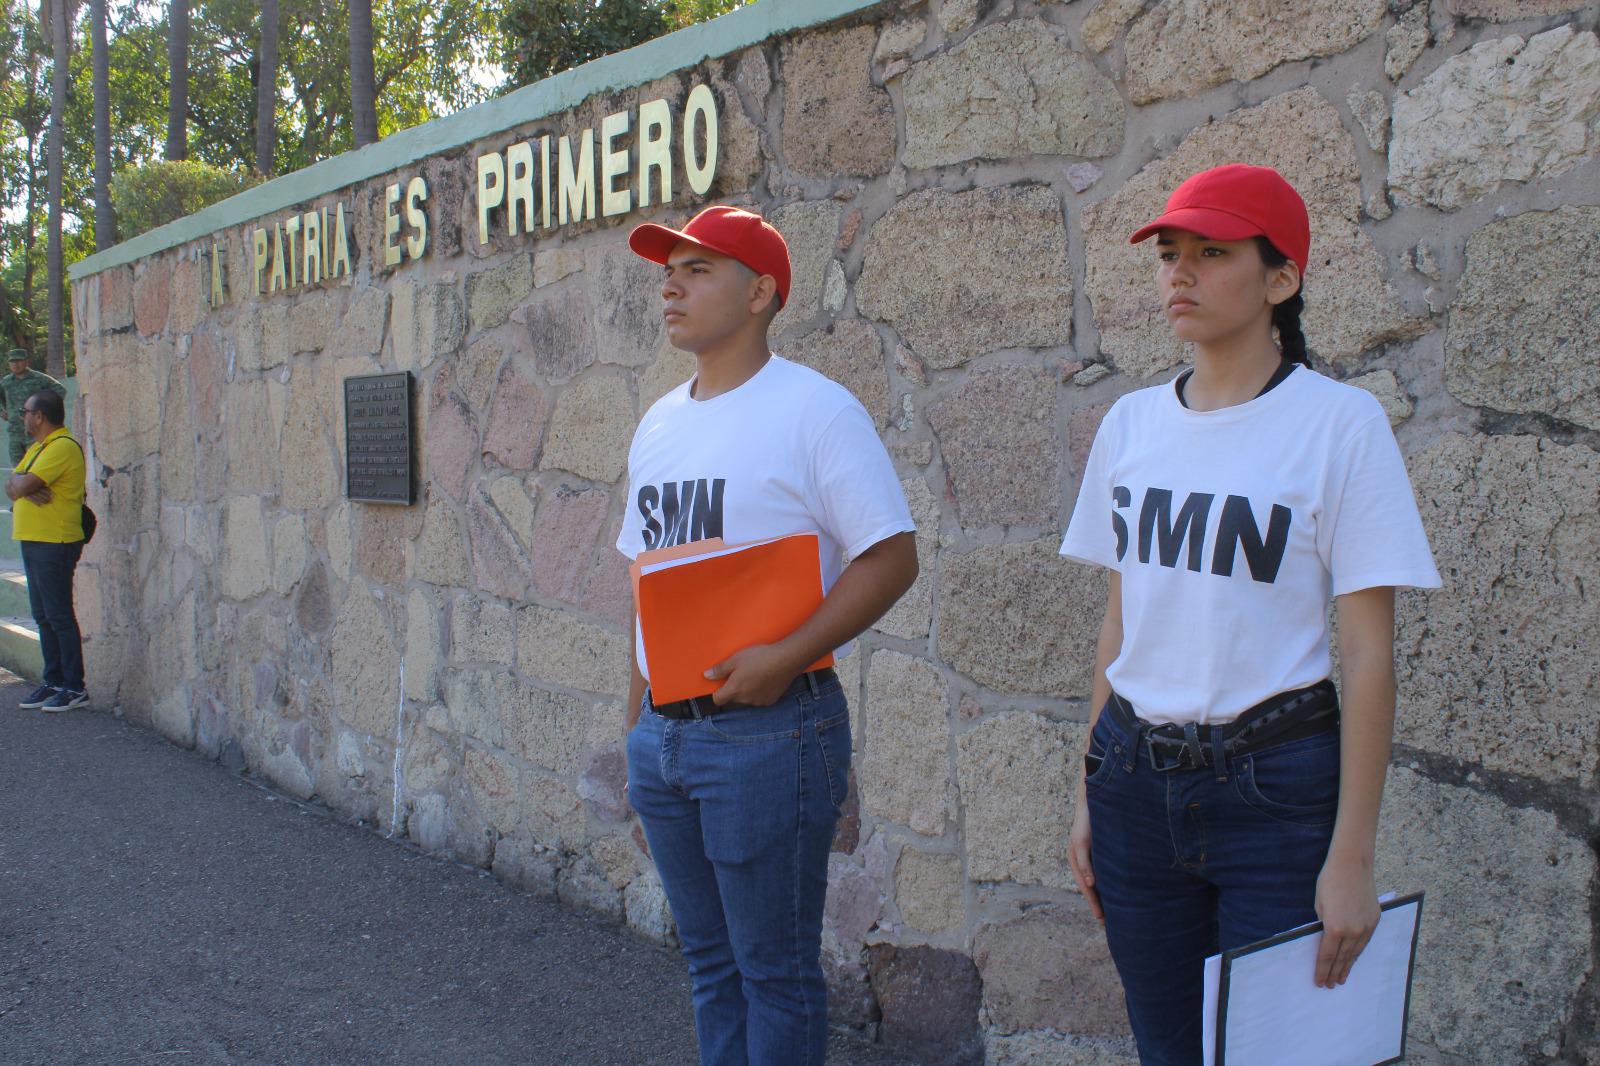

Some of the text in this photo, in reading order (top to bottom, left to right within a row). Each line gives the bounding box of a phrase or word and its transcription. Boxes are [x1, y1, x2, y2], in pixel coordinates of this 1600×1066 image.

[253, 202, 351, 297] PATRIA
[385, 176, 428, 266] ES
[477, 84, 718, 245] PRIMERO
[638, 478, 726, 551] SMN
[1112, 485, 1292, 584] SMN
